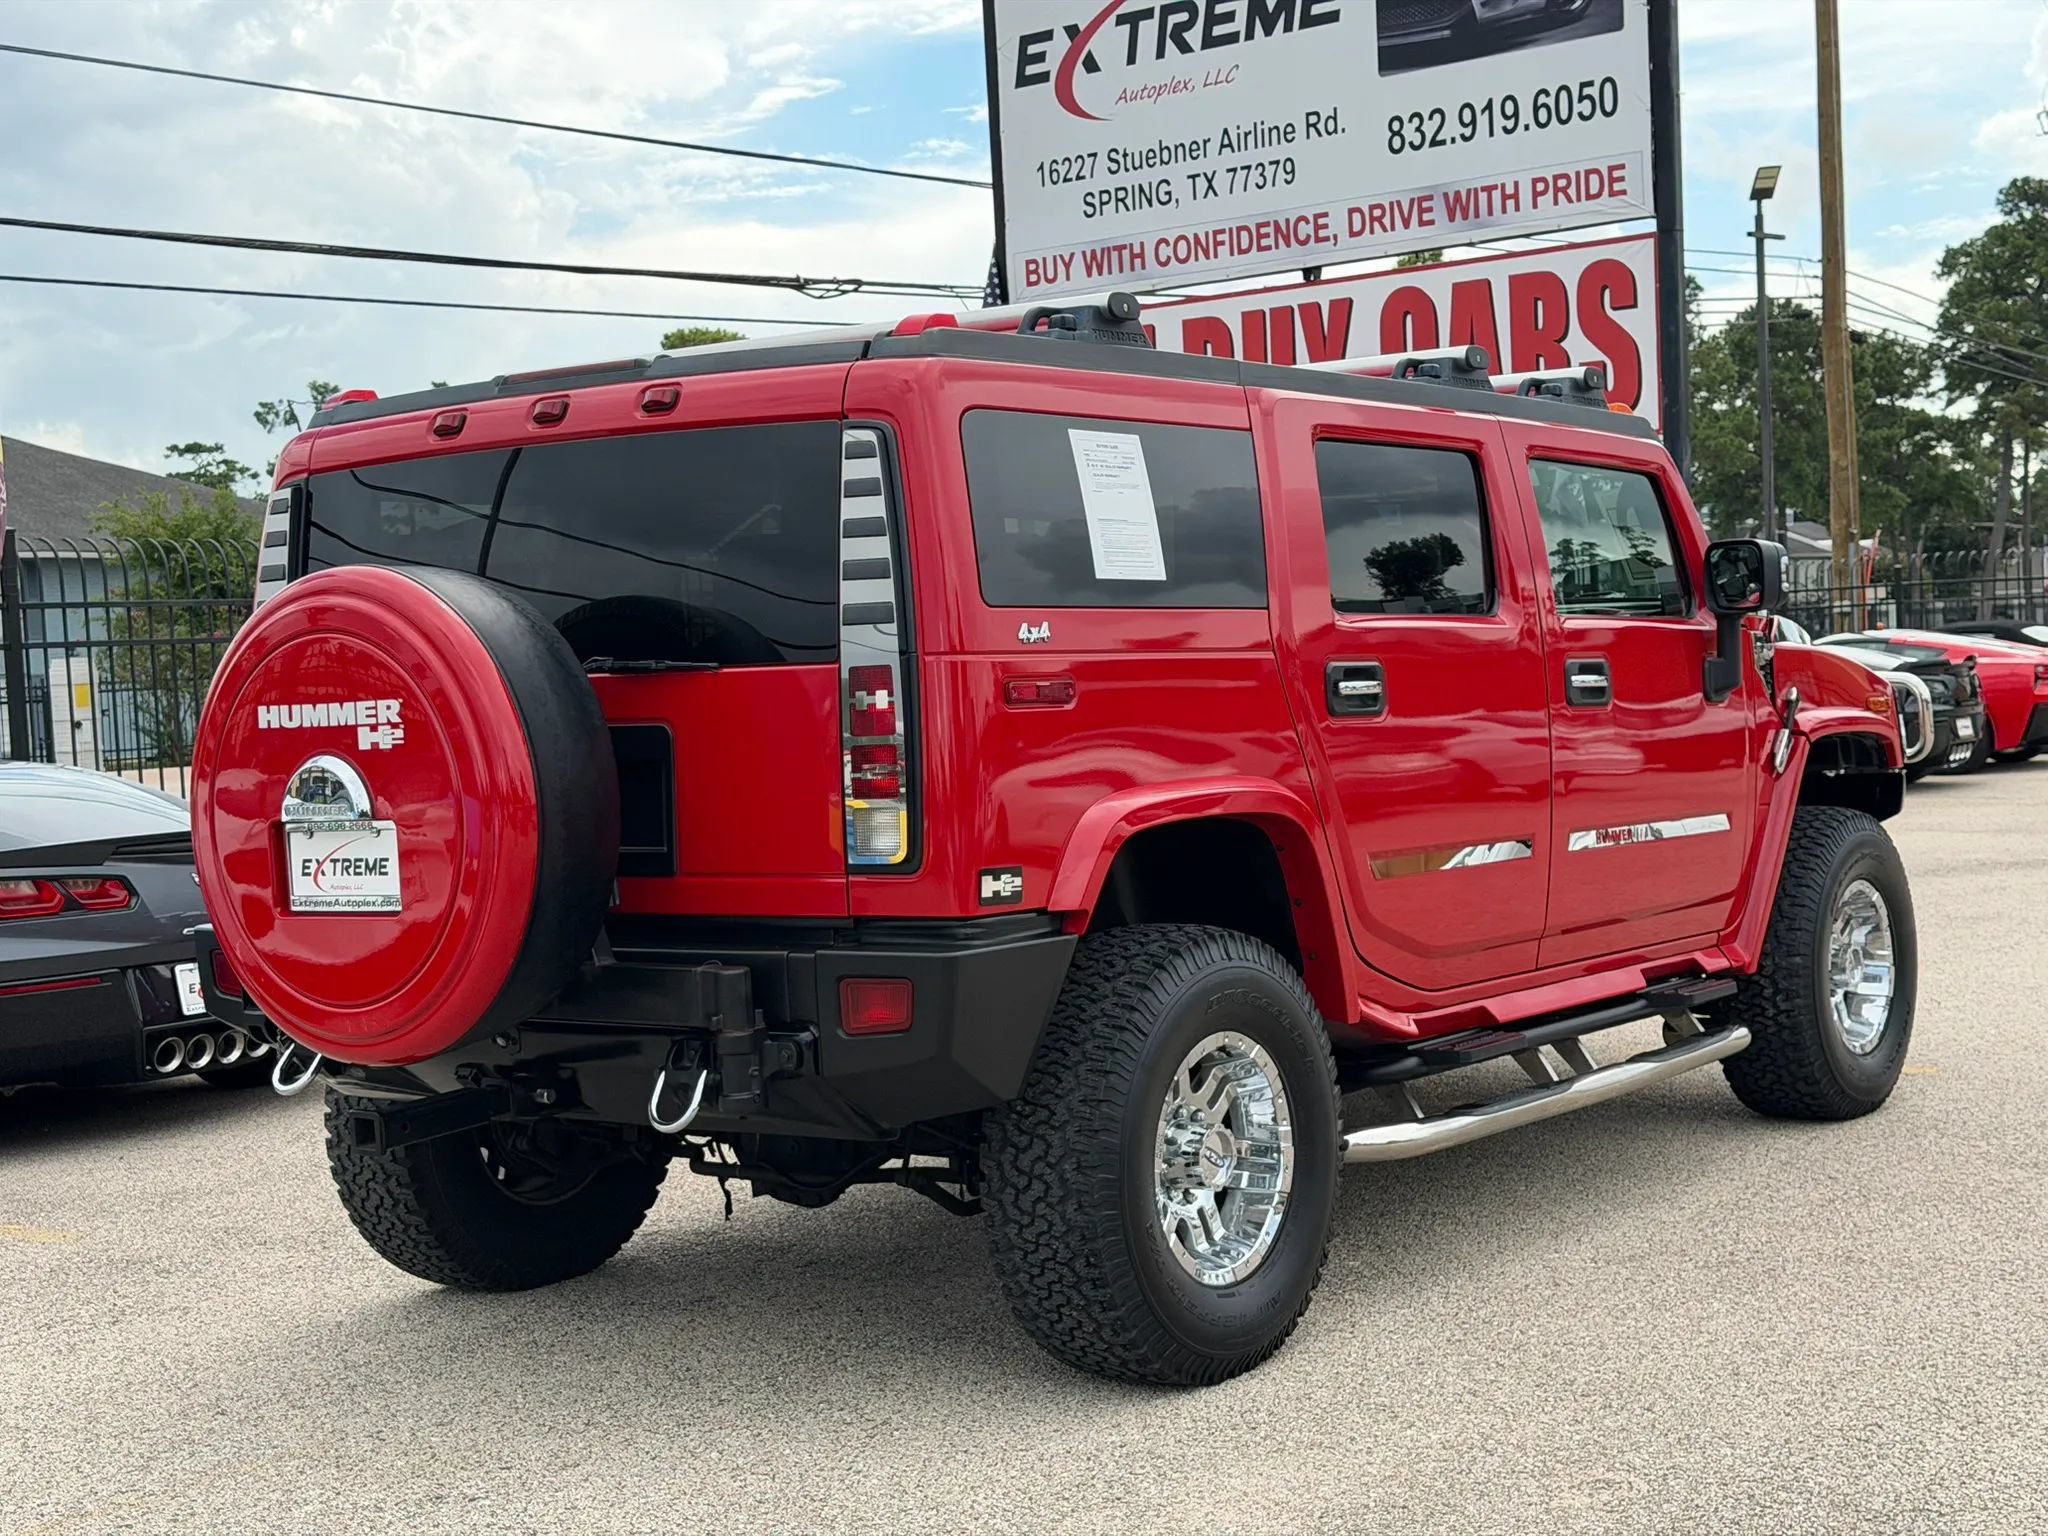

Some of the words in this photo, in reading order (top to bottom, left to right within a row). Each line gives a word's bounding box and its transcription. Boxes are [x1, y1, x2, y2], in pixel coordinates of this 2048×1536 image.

[1014, 0, 1341, 91] EXTREME
[1115, 75, 1196, 105] Autoplex,
[1203, 64, 1240, 87] LLC
[1387, 76, 1619, 155] 832.919.6050
[1036, 152, 1098, 188] 16227
[1107, 136, 1211, 175] Stuebner
[1218, 120, 1297, 156] Airline
[1305, 107, 1346, 140] Rd.
[1083, 179, 1180, 219] SPRING,
[1187, 170, 1219, 201] TX
[1226, 157, 1296, 195] 77379
[1024, 252, 1075, 288] BUY
[1082, 241, 1146, 279] WITH
[1154, 212, 1339, 269] CONFIDENCE,
[1348, 194, 1436, 239] DRIVE
[1443, 180, 1520, 223] WITH
[1532, 163, 1628, 210] PRIDE
[1018, 621, 1051, 643] 4x4
[257, 699, 403, 729] HUMMER
[357, 724, 405, 750] H2
[301, 857, 390, 877] EXTREME
[981, 873, 1023, 898] H2
